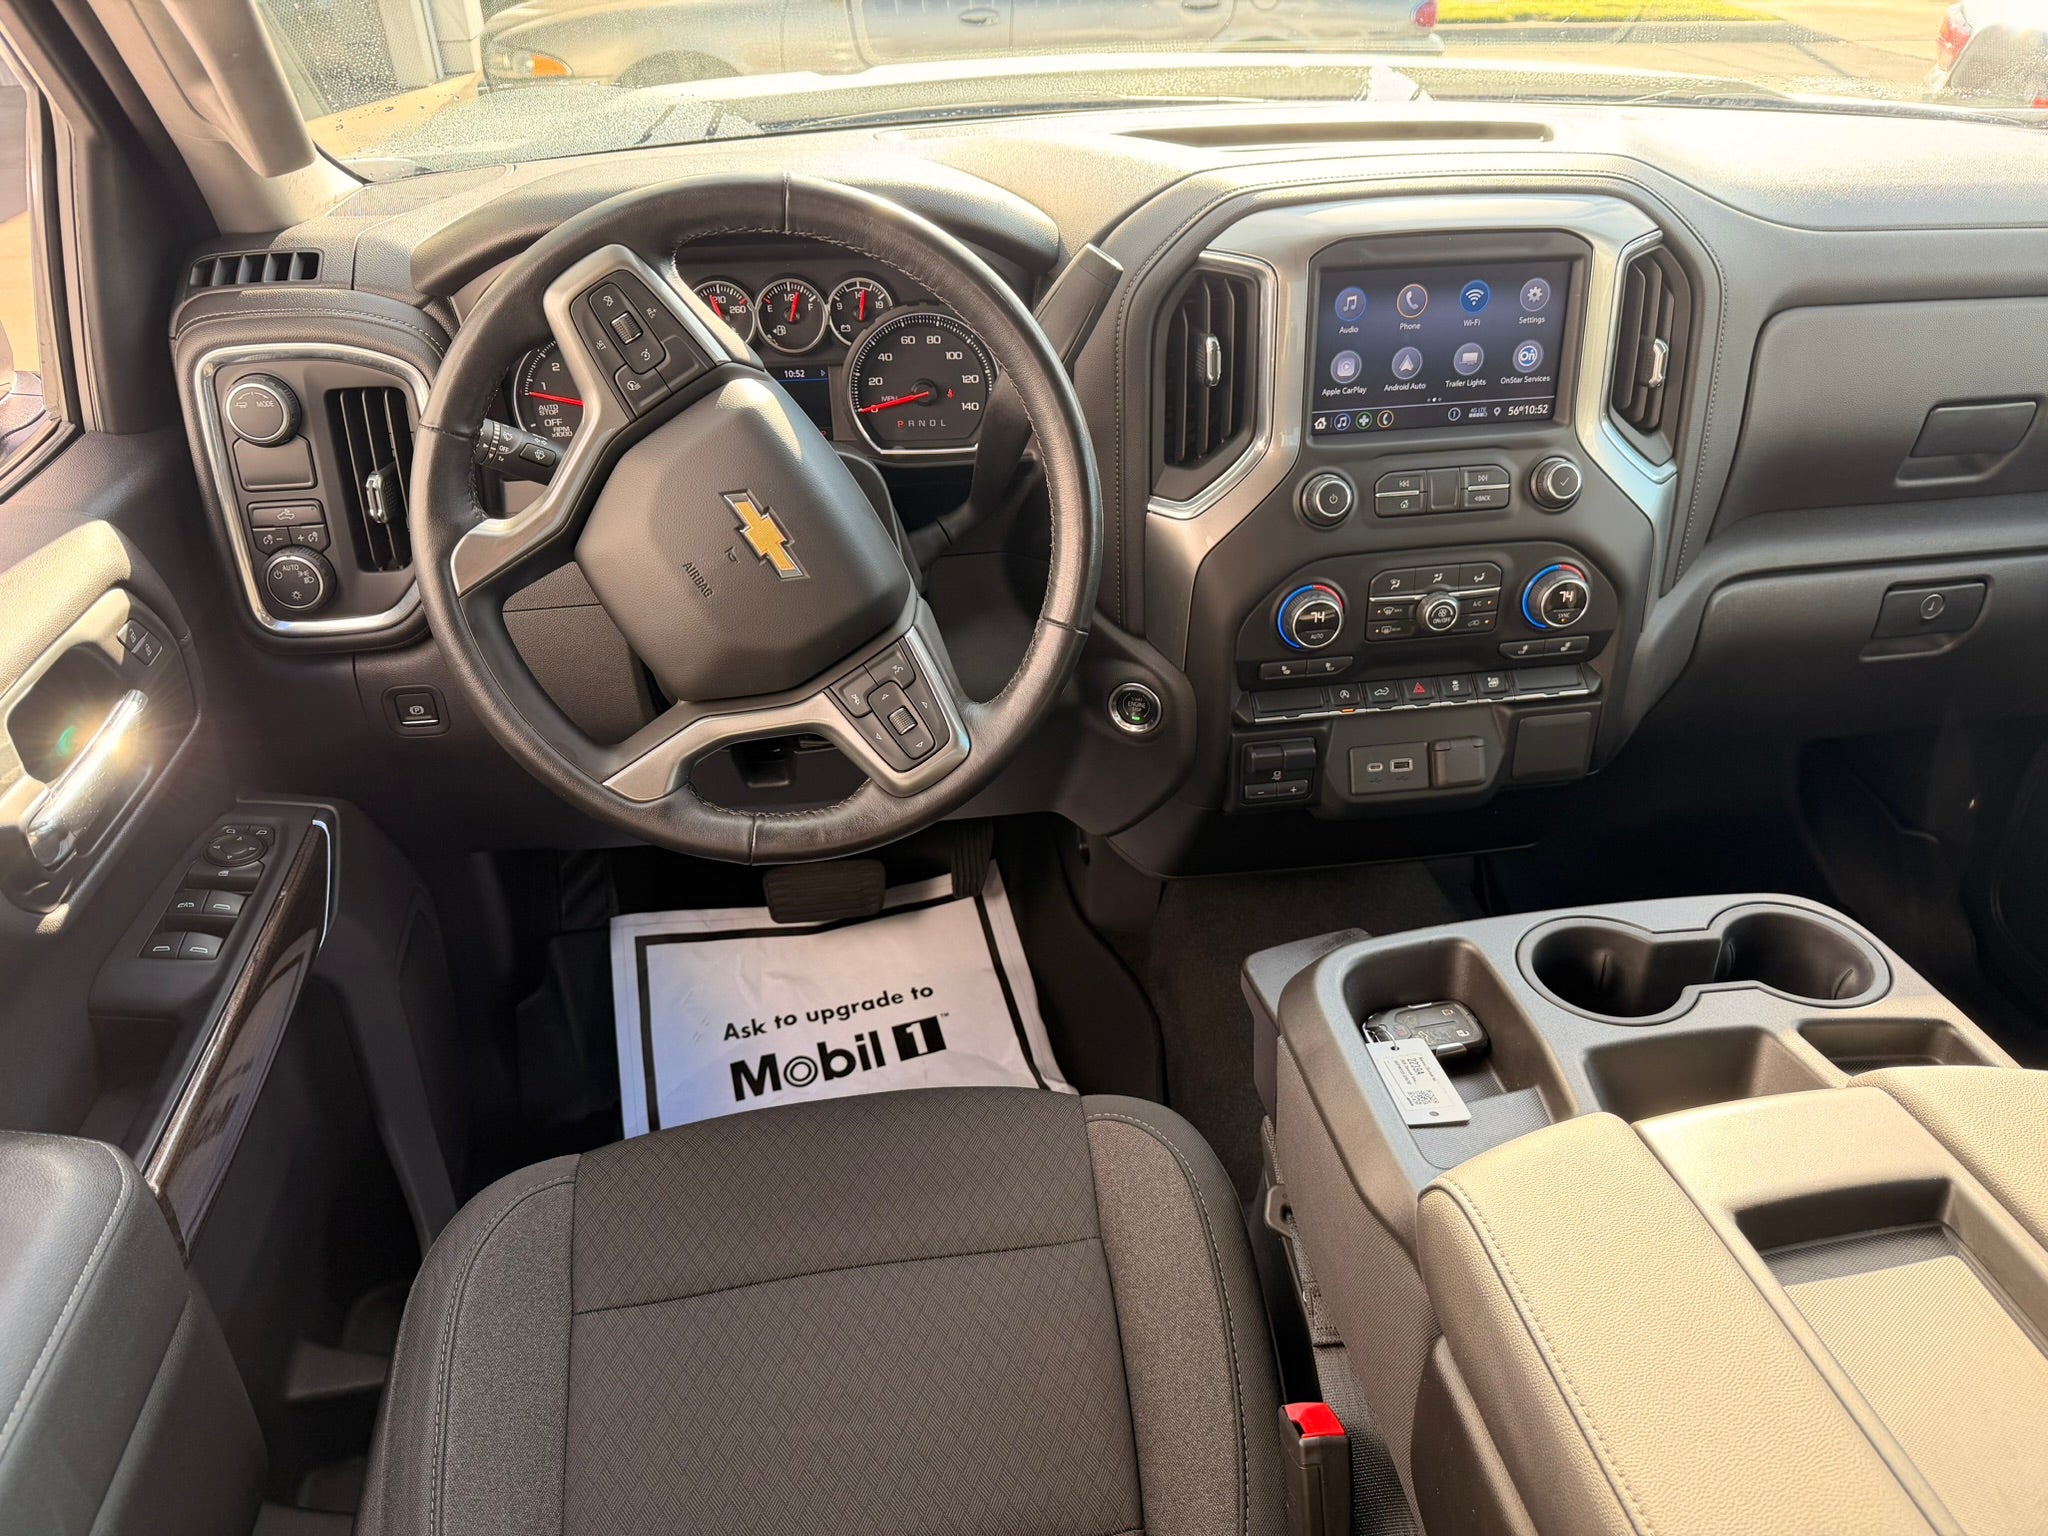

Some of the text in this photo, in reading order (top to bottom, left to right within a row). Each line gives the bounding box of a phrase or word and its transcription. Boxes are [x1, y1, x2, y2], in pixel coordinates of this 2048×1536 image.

[729, 305, 747, 314] 260
[767, 304, 773, 313] E
[807, 303, 814, 311] F
[836, 302, 843, 310] 9
[875, 300, 884, 309] 19
[1463, 318, 1481, 327] Wi-Fi
[1519, 316, 1546, 325] Settings
[1339, 326, 1359, 334] Audio
[1399, 322, 1421, 330] Phone
[901, 335, 916, 345] 60
[926, 335, 941, 345] 80
[878, 352, 893, 362] 40
[945, 351, 963, 360] 100
[551, 362, 560, 372] 2
[784, 368, 805, 378] 10:52
[868, 377, 883, 386] 20
[961, 374, 980, 384] 120
[1445, 378, 1487, 388] Trailer Lights
[1500, 375, 1550, 385] OnStar Services
[1321, 386, 1367, 397] Apple CarPlay
[1383, 382, 1426, 391] Android Auto
[256, 400, 275, 408] MODE
[961, 401, 979, 411] 140
[1524, 404, 1549, 414] 10:52
[544, 418, 563, 427] OFF
[682, 561, 714, 599] AIRBAG
[1560, 590, 1573, 603] 74
[1310, 611, 1325, 623] 74
[723, 986, 934, 1041] Ask to upgrade to
[729, 1030, 887, 1102] Mobil
